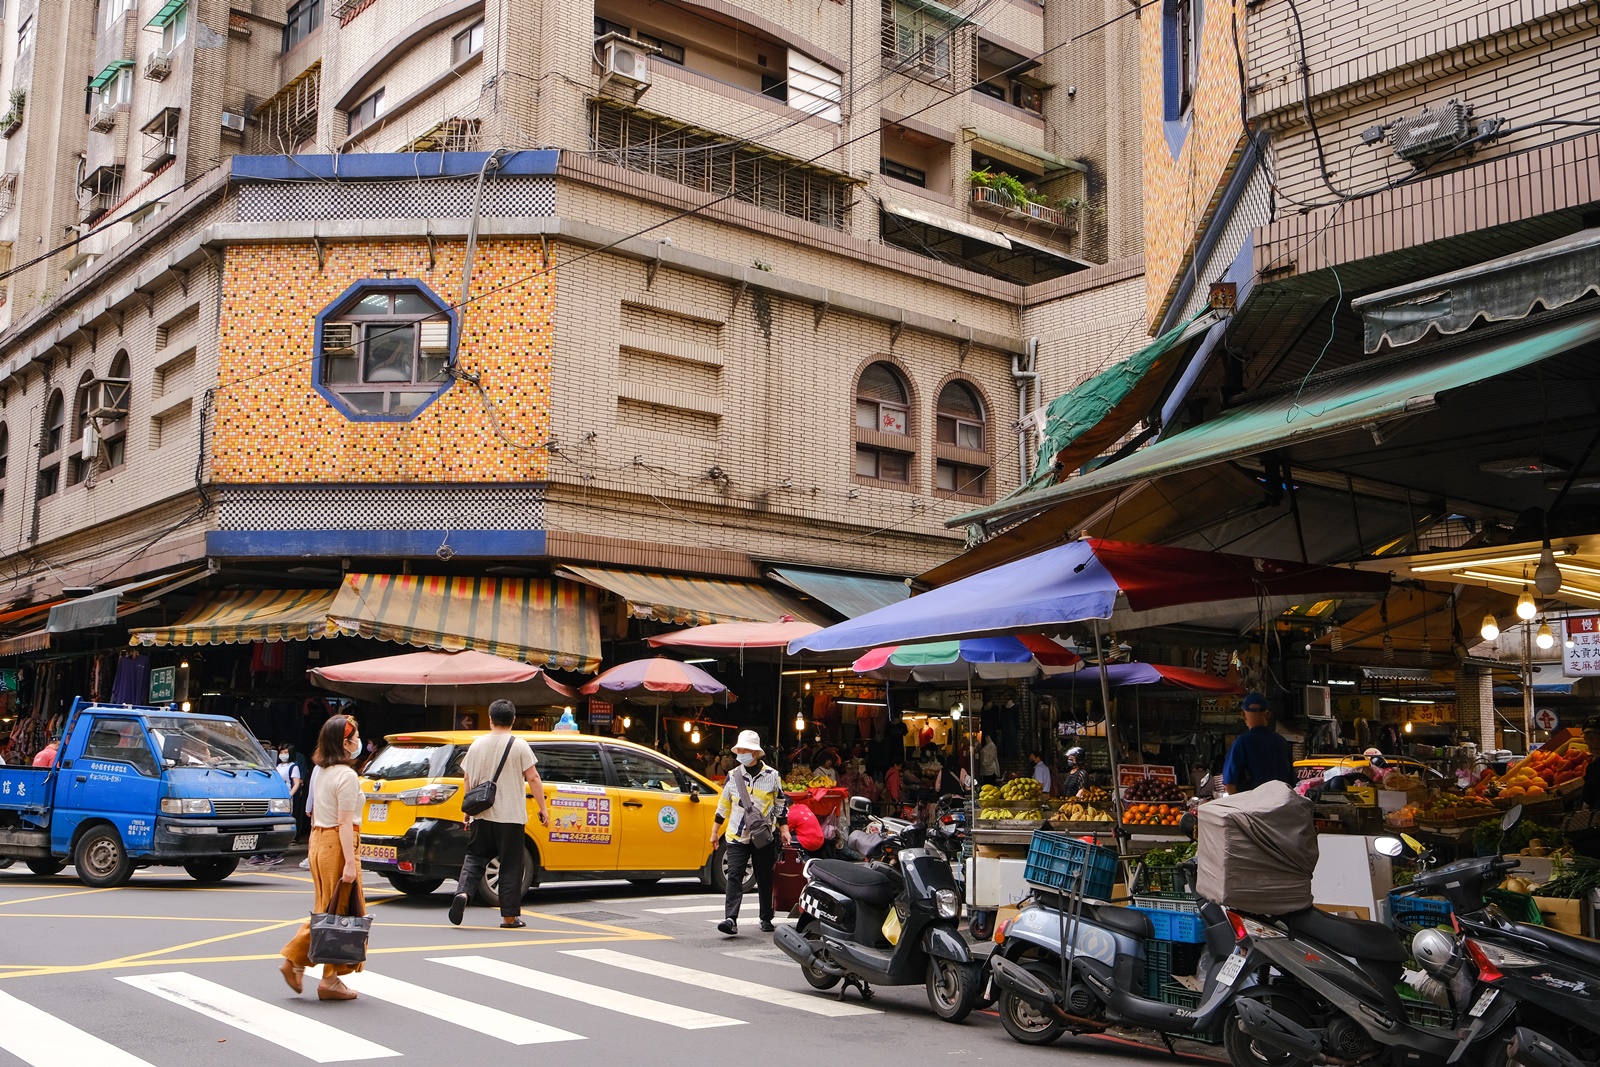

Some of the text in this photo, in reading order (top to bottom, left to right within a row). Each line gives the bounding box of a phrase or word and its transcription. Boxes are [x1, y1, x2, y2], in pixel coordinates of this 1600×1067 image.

[153, 670, 172, 686] 仁四路
[588, 813, 610, 826] 大象
[569, 833, 610, 842] 2421-6688
[360, 845, 396, 859] 23-6666
